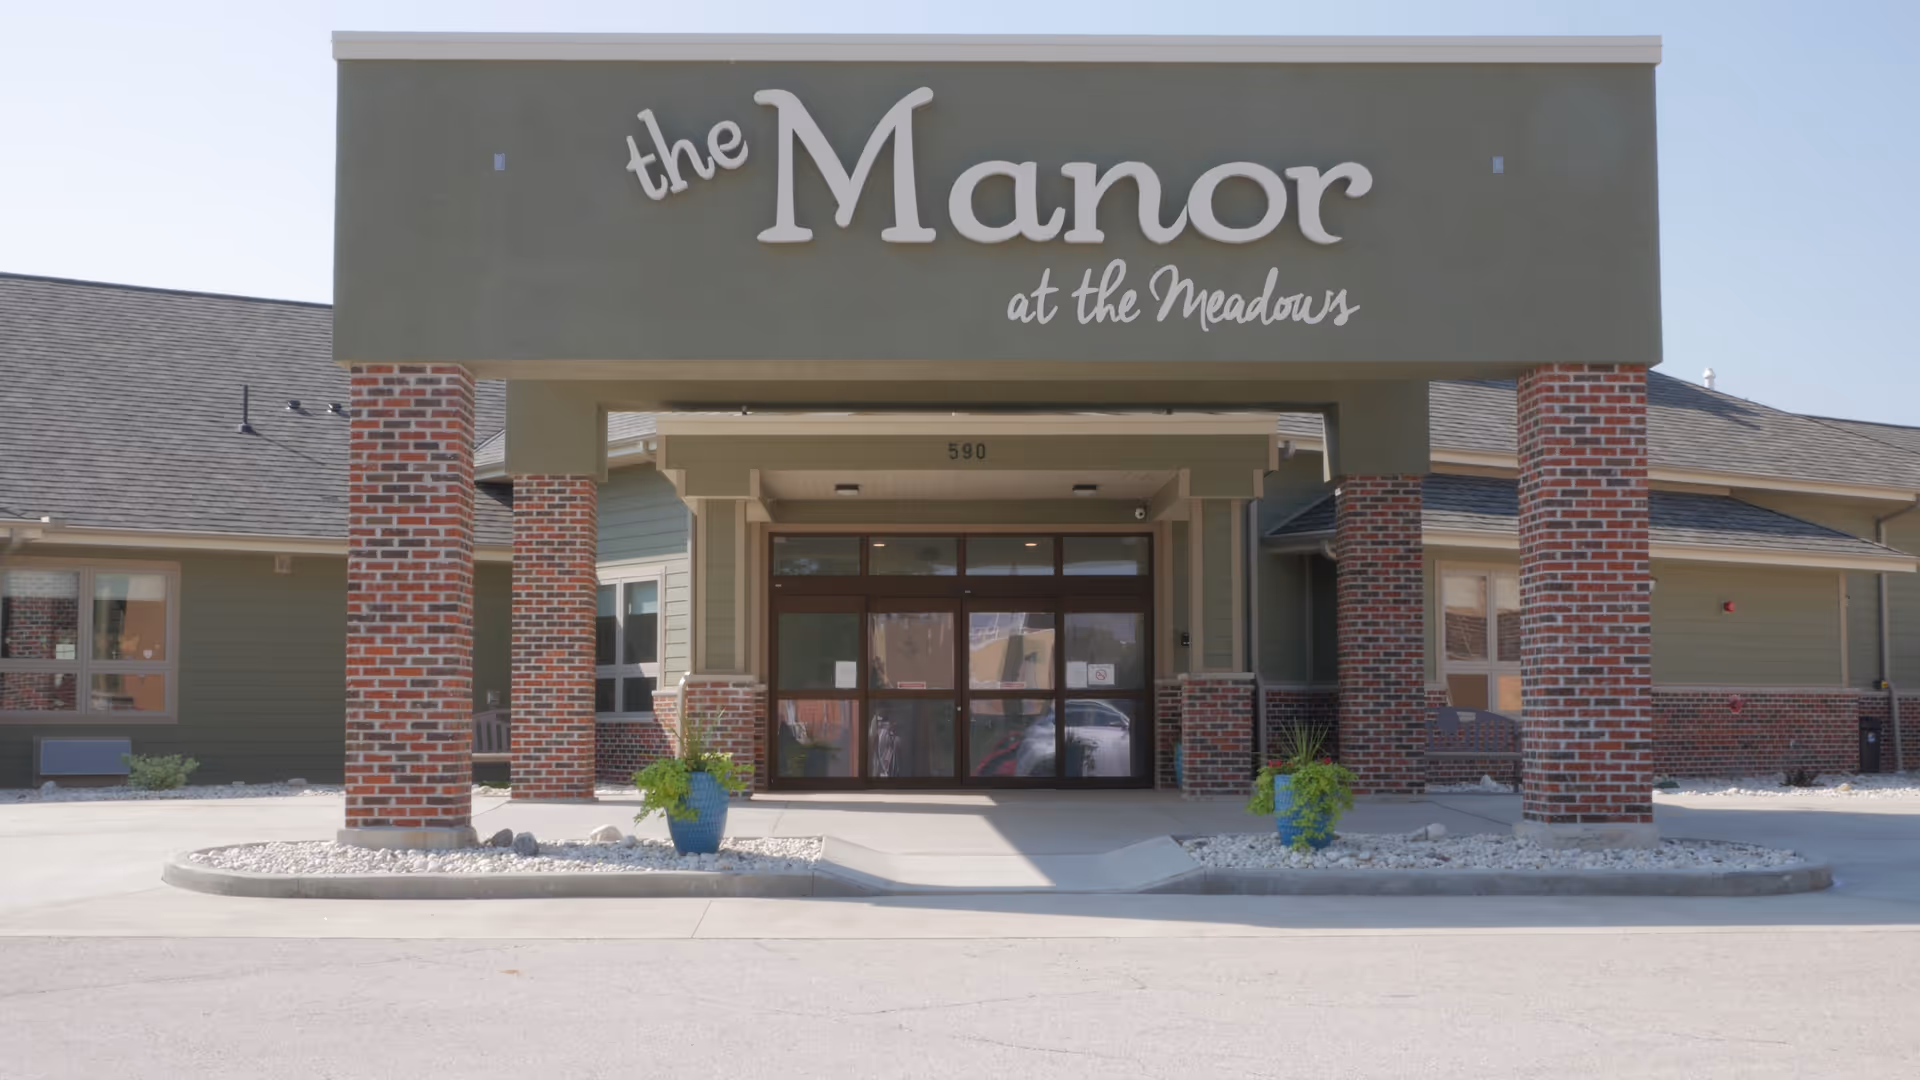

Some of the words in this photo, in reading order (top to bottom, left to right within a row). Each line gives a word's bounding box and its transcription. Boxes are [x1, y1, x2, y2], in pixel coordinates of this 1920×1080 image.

[625, 108, 749, 201] the
[753, 86, 1373, 244] Manor
[1006, 267, 1060, 325] at
[1071, 258, 1142, 325] the
[1149, 264, 1361, 332] Meadows
[948, 443, 986, 460] 590
